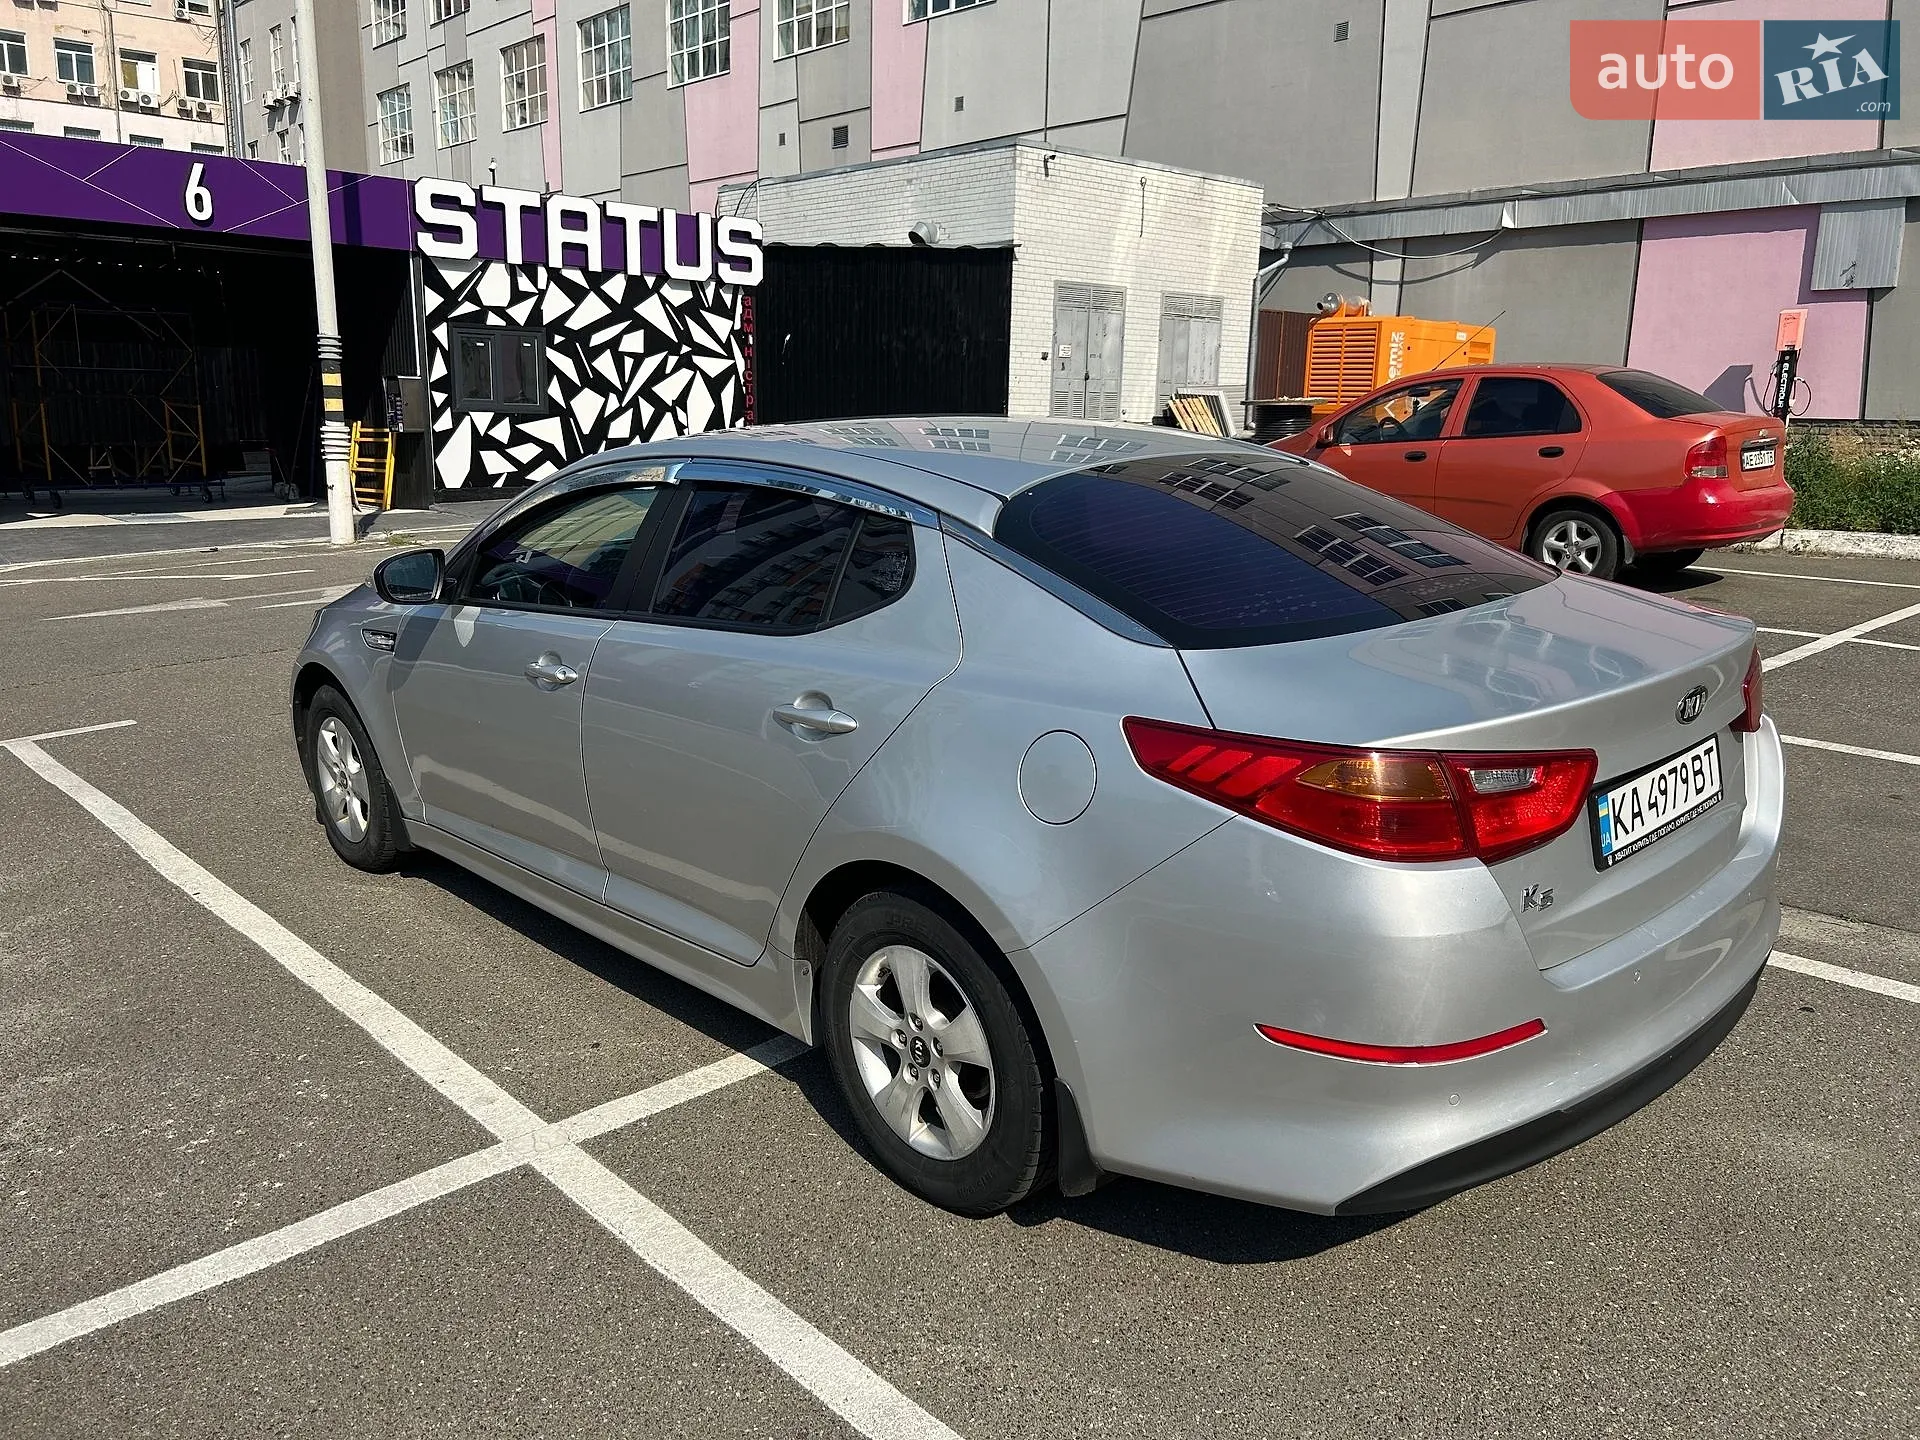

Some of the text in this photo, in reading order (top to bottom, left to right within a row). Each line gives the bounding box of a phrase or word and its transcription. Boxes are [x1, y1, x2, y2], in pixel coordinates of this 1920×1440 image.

[185, 162, 213, 221] 6
[414, 175, 764, 288] STATUS
[1683, 691, 1706, 719] KIA
[1611, 745, 1714, 841] KA 4979 BT
[1601, 831, 1612, 848] UA
[1520, 883, 1554, 913] K5
[914, 1040, 923, 1063] KIA
